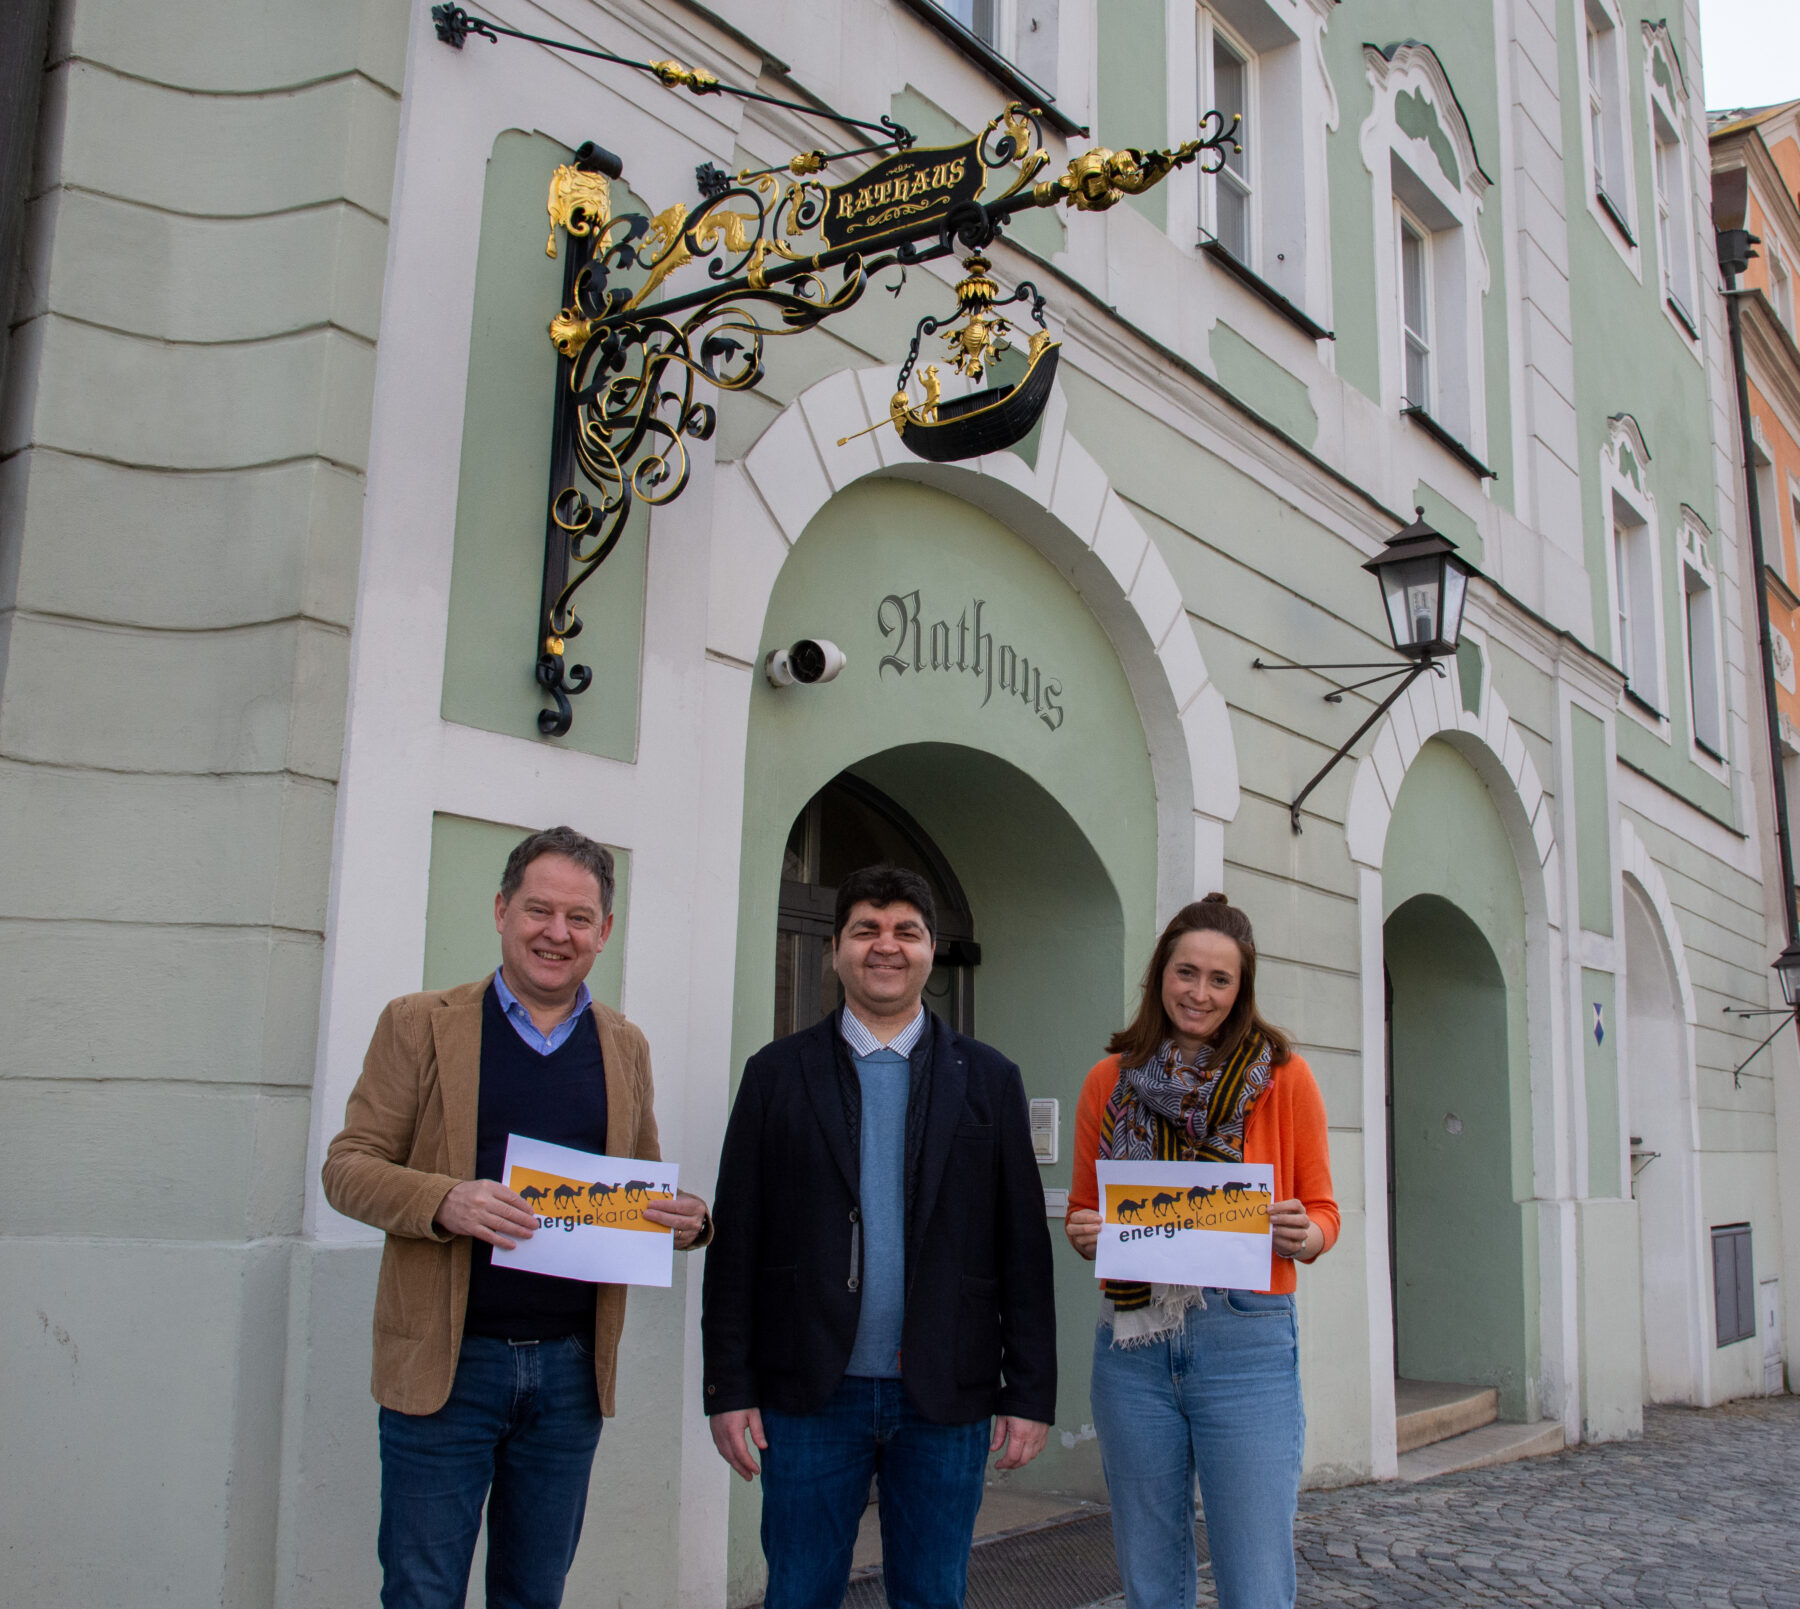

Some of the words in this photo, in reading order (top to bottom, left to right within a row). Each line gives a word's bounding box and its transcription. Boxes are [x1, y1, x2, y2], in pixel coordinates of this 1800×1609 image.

[836, 156, 967, 219] RATHAUS
[878, 589, 1064, 732] Rathaus
[536, 1207, 644, 1232] nergiekara
